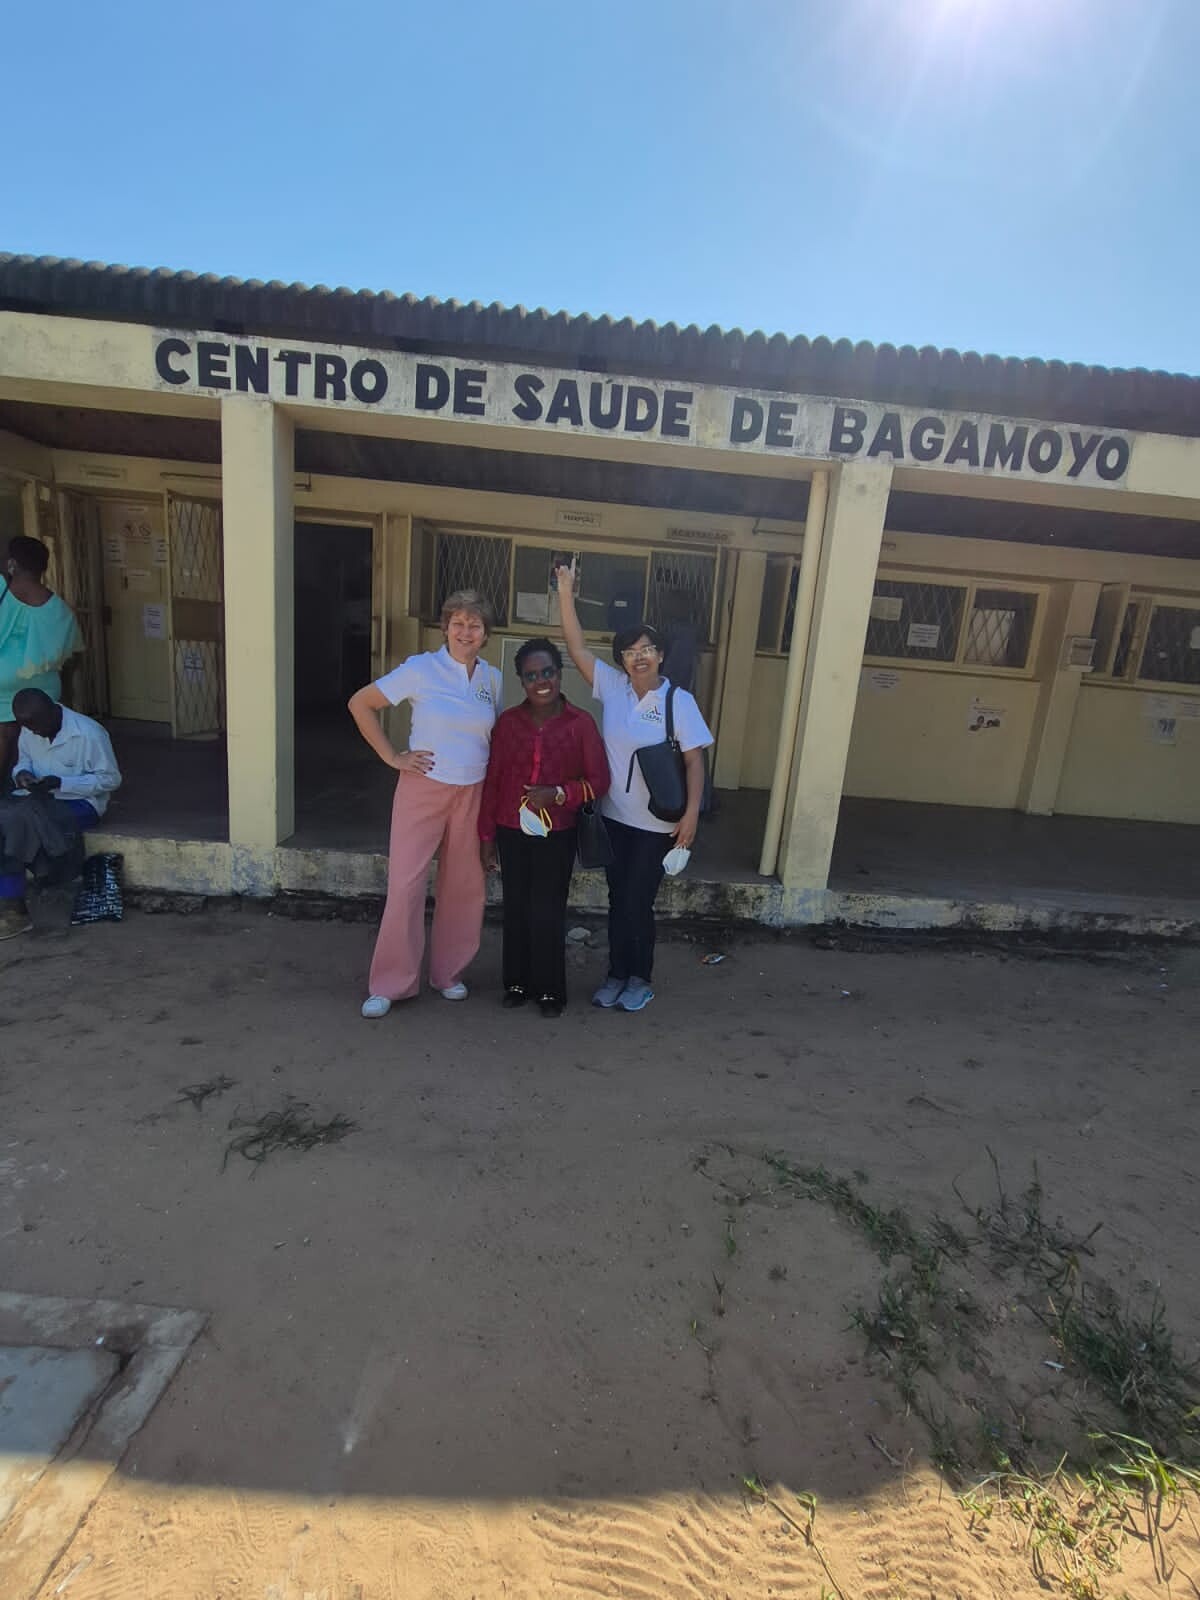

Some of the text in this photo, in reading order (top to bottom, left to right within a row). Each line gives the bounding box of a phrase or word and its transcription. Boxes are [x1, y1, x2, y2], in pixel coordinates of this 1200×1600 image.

[155, 338, 1130, 481] CENTRO DE SAÚDE DE BAGAMOYO
